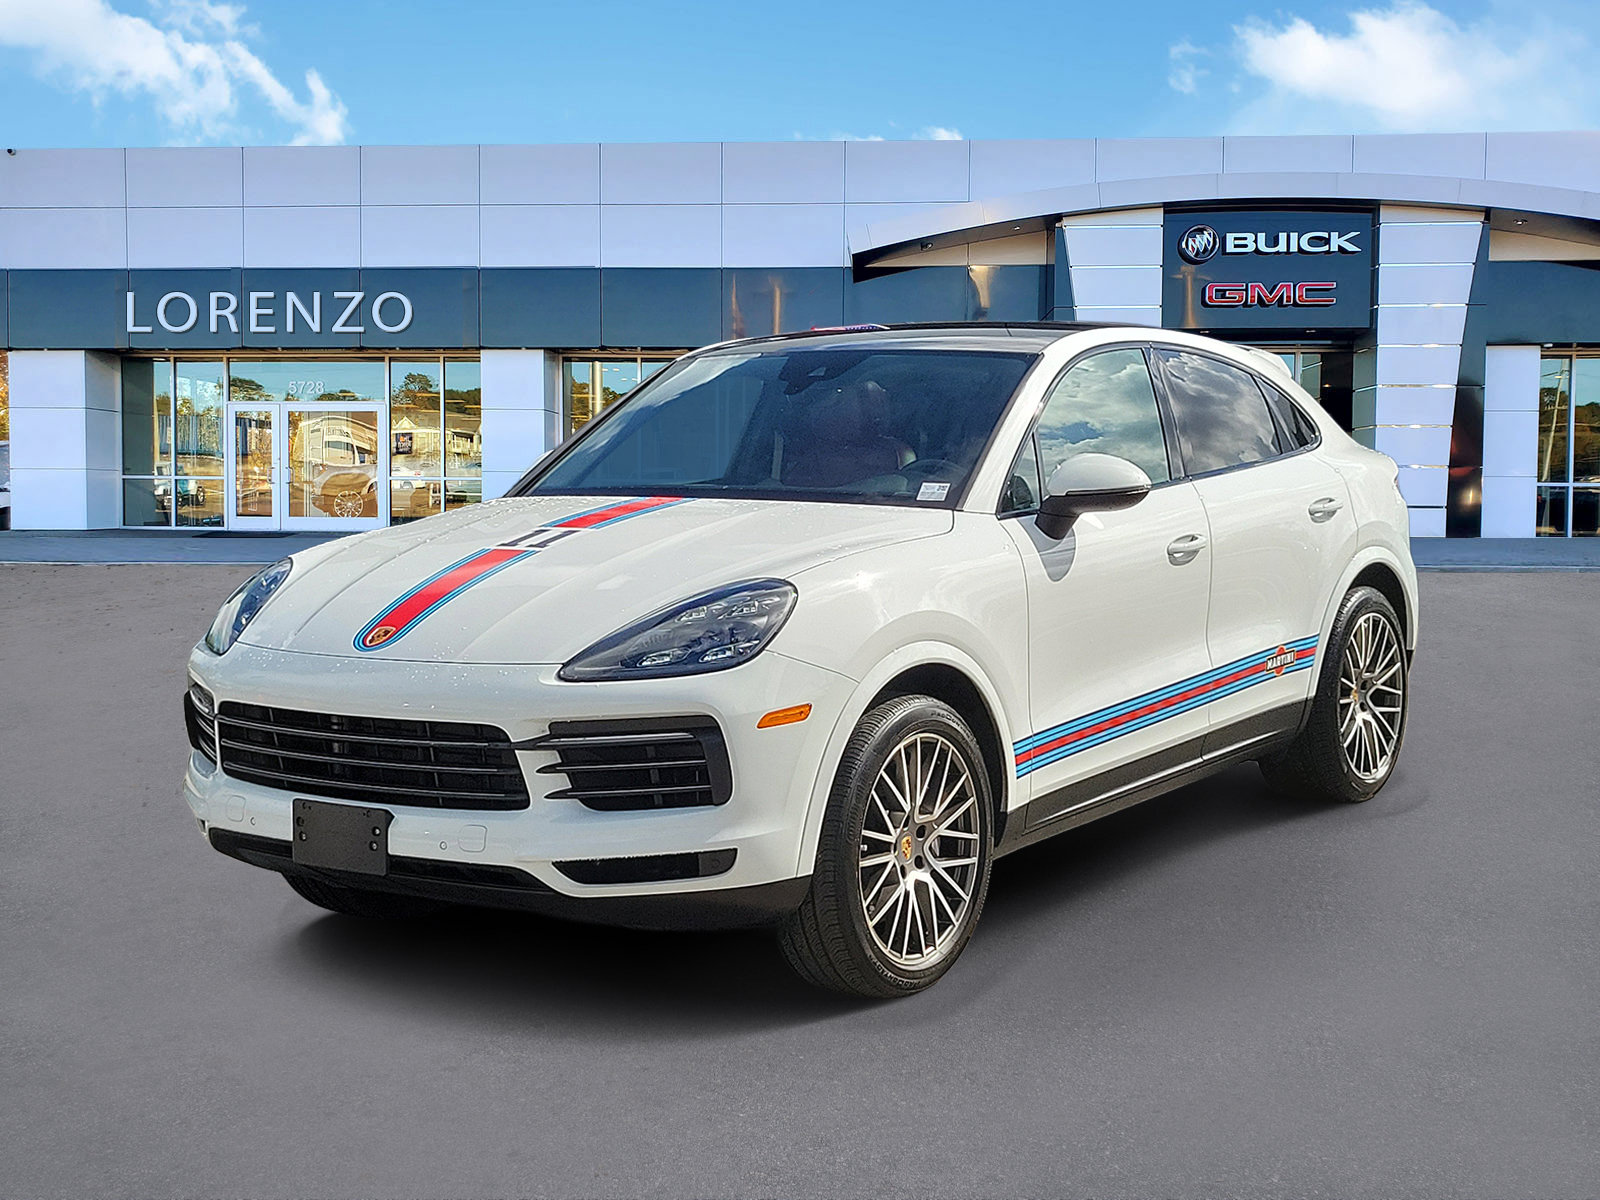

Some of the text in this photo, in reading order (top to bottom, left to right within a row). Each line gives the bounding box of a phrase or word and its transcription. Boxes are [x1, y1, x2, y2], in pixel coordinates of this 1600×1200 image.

[1226, 231, 1362, 252] BUICK
[1205, 282, 1337, 305] GMC
[126, 291, 414, 333] LORENZO
[288, 380, 325, 394] 5728
[1266, 651, 1295, 671] MARTINI
